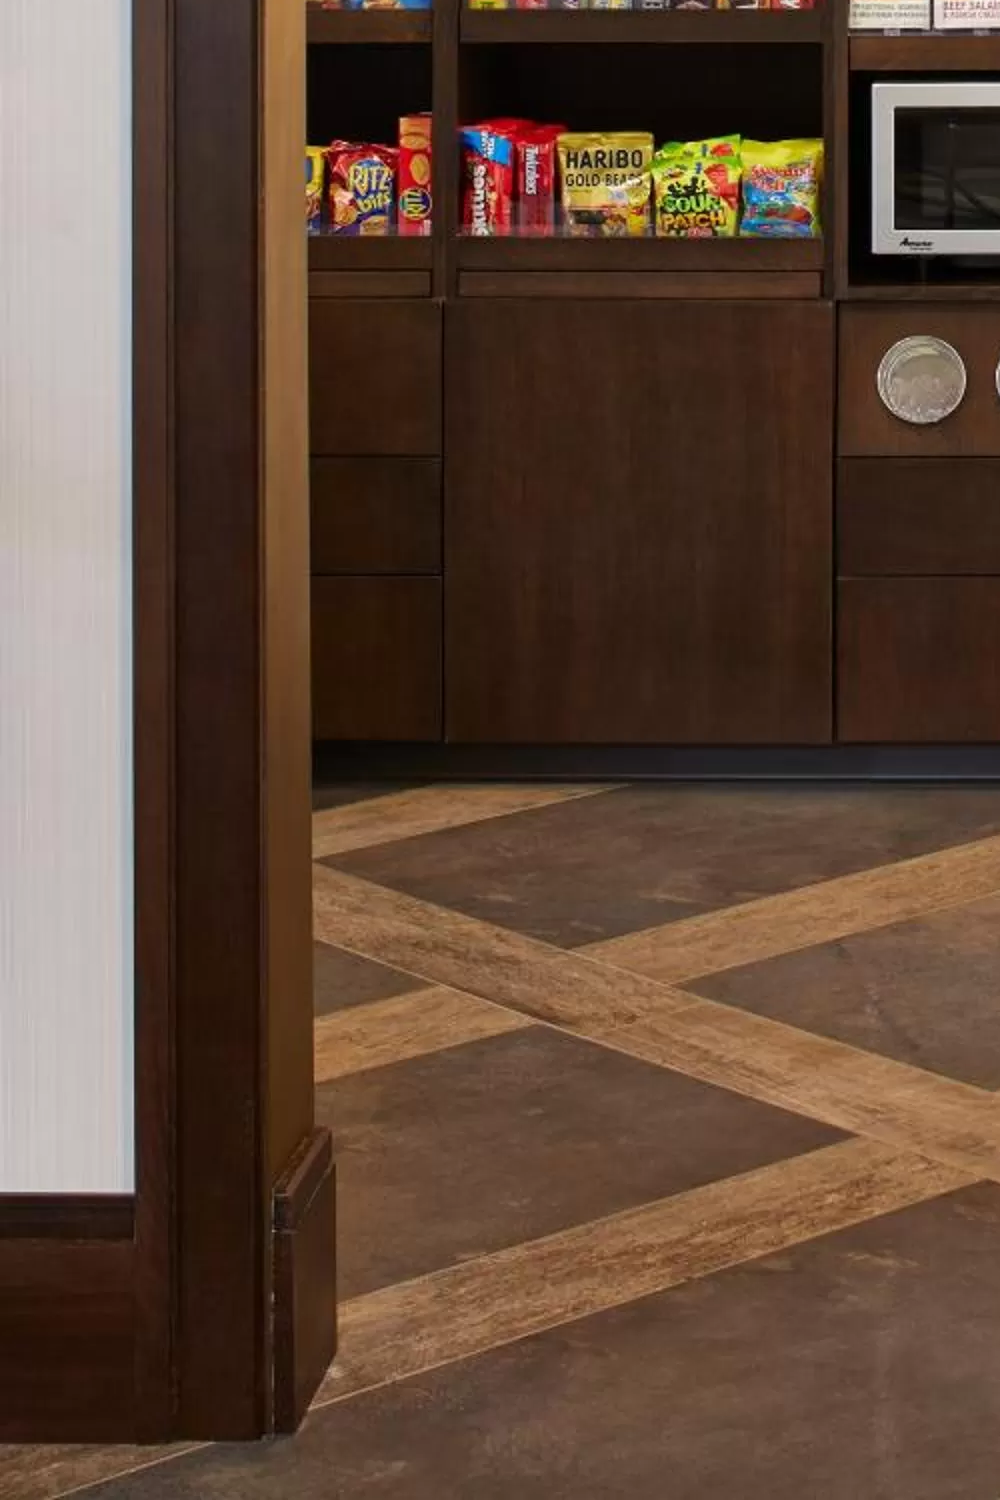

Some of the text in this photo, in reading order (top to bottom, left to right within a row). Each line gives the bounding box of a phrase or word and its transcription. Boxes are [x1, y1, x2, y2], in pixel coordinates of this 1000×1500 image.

[566, 149, 643, 169] HARIBO
[348, 164, 392, 195] RITZ
[662, 193, 722, 213] SOUR
[662, 210, 725, 232] PATCH
